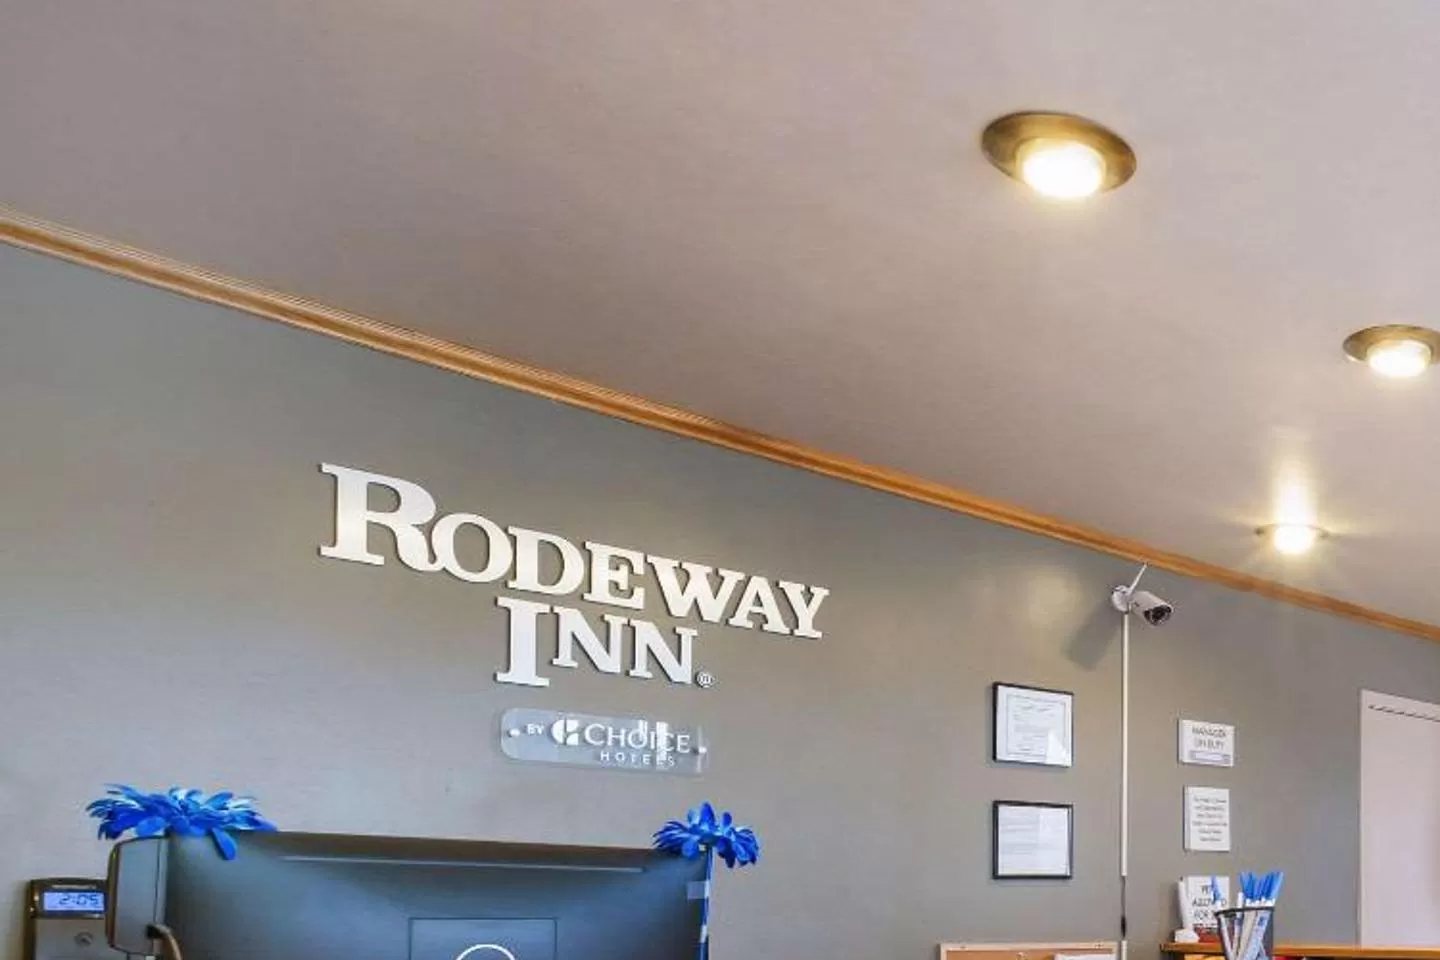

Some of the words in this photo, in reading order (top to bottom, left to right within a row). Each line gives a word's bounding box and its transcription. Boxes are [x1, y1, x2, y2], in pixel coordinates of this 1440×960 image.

[317, 461, 830, 640] RODEWAY
[494, 596, 699, 688] INN
[527, 723, 545, 736] BY
[584, 722, 691, 755] CHOICE
